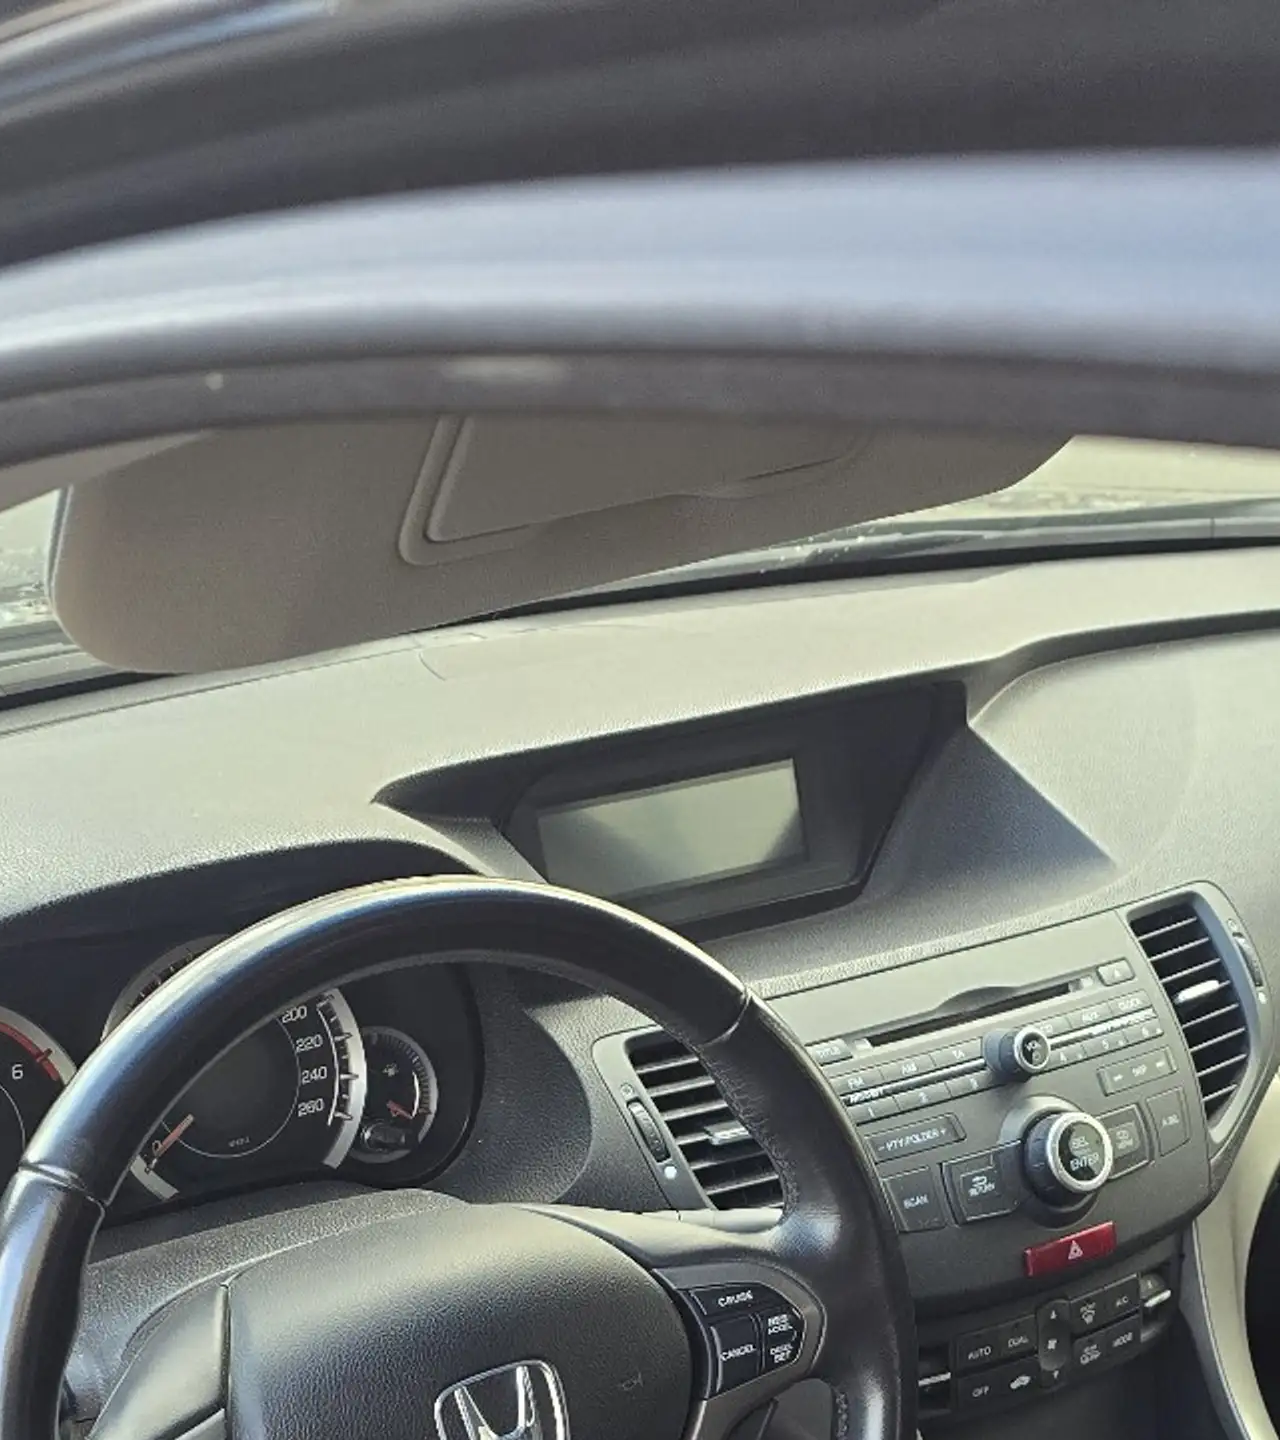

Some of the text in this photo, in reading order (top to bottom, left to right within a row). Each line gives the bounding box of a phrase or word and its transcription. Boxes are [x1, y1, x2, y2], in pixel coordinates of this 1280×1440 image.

[281, 1005, 308, 1024] 200
[295, 1034, 324, 1055] 220
[11, 1063, 25, 1081] 6
[301, 1066, 328, 1086] 240
[297, 1098, 325, 1118] 260
[1069, 1151, 1100, 1172] ENTER
[903, 1193, 929, 1209] SCAN
[719, 1343, 757, 1361] CANCEL
[967, 1346, 992, 1361] AUTO
[972, 1385, 990, 1398] OFF
